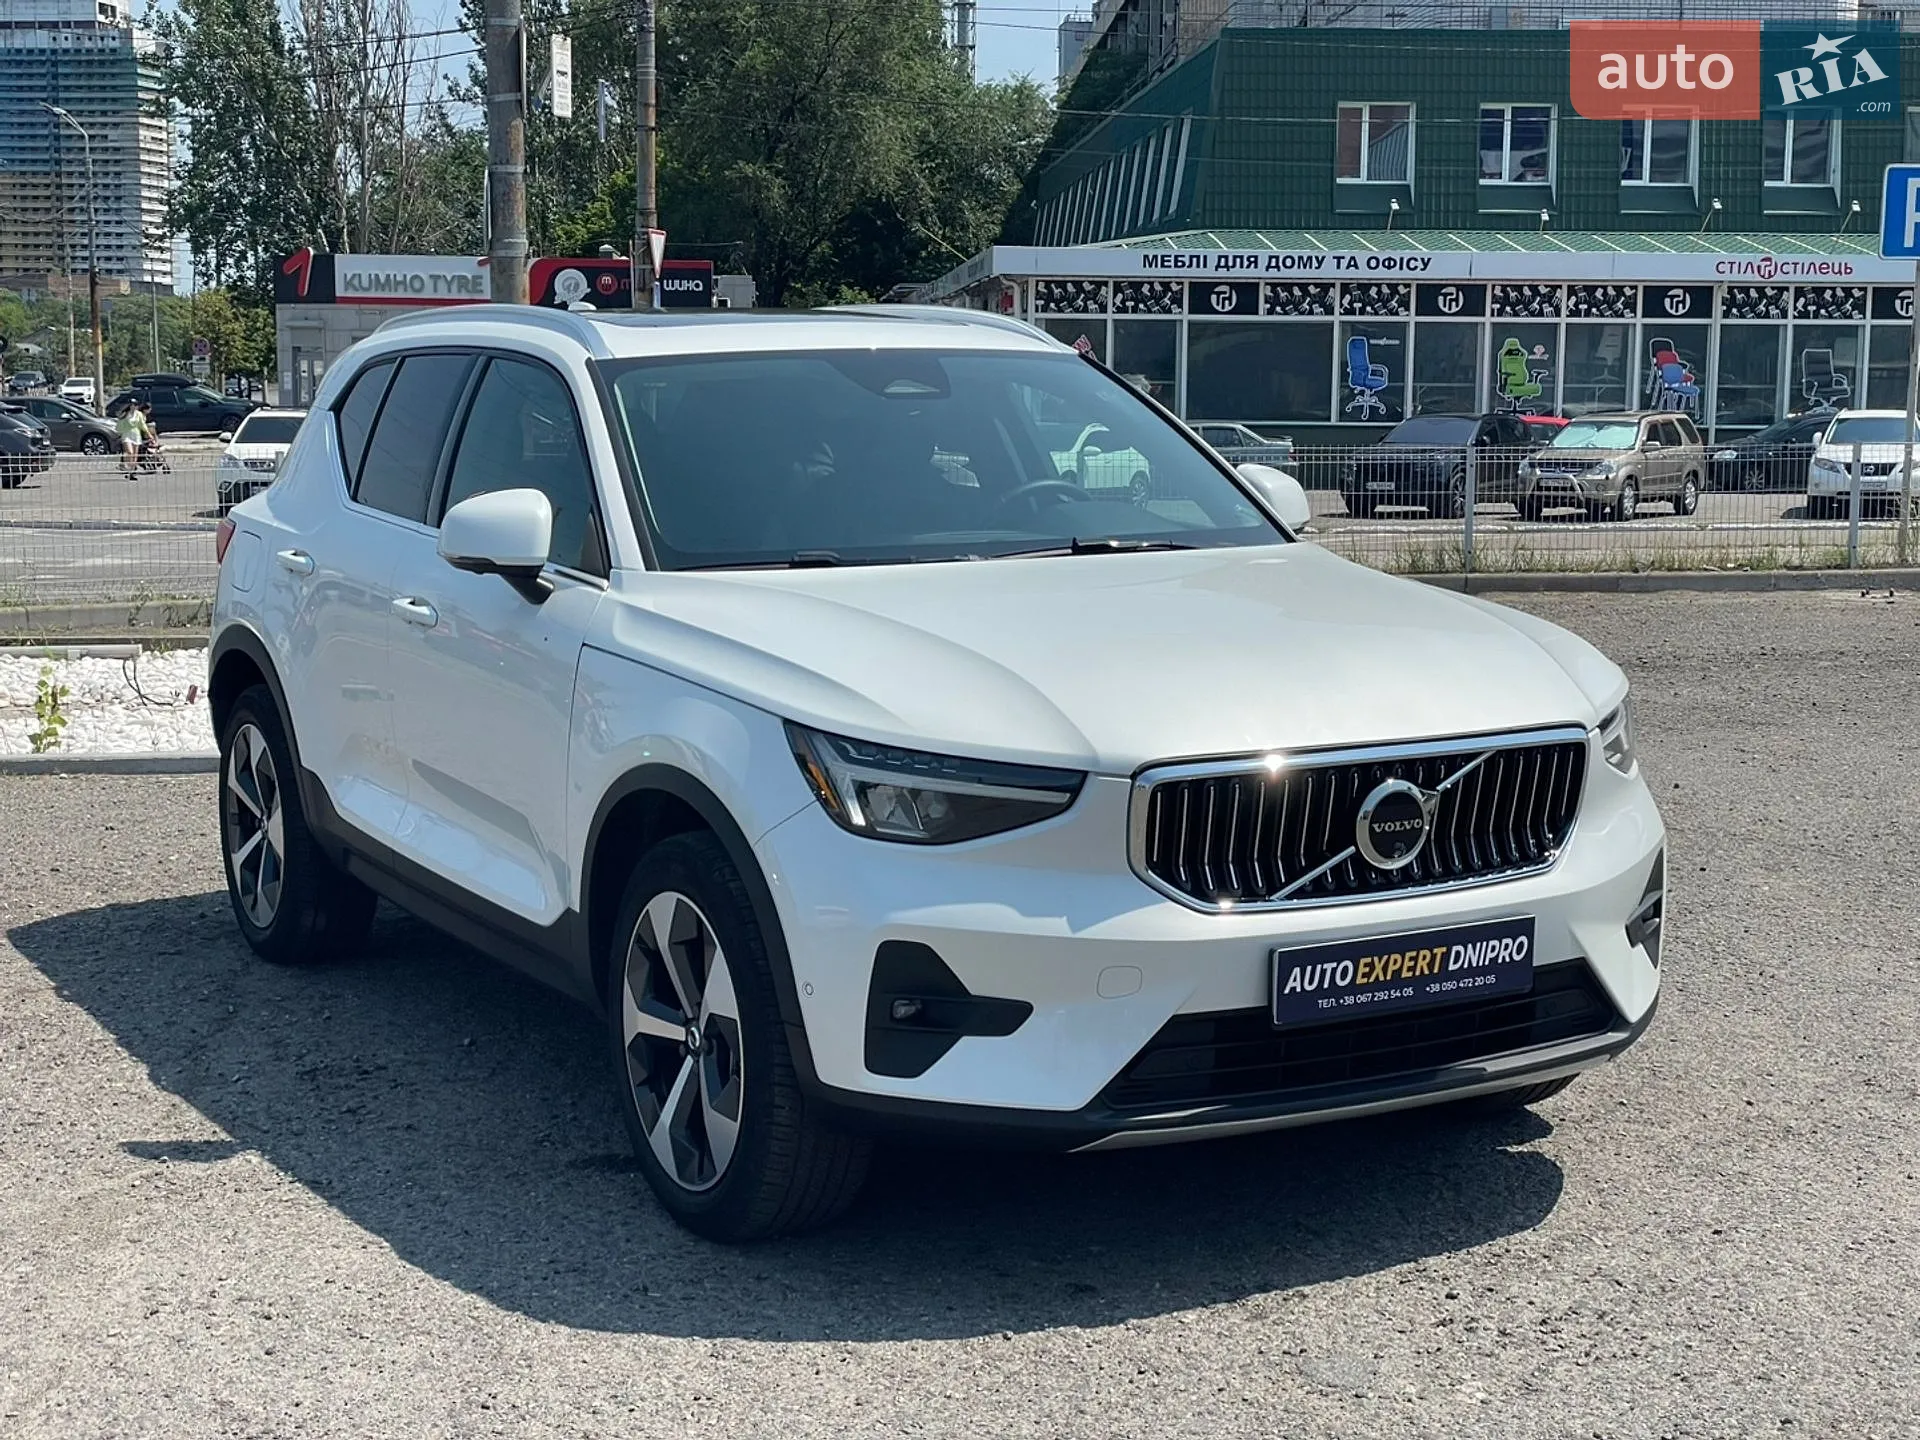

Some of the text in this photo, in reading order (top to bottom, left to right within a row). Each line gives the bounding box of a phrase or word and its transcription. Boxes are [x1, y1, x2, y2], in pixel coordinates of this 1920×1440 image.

[1142, 254, 1432, 272] МЕБЛІ ДЛЯ ДОМУ ТА ОФІСУ
[343, 272, 485, 295] KUMHO TYRE
[1371, 818, 1423, 832] VOLVO
[1283, 935, 1528, 994] AUTO EXPERT DNIPRO
[1425, 974, 1497, 993] +38 050 472 20 05
[1339, 996, 1354, 1006] +38
[1356, 993, 1372, 1004] 067
[1374, 990, 1388, 1001] 292
[1390, 988, 1401, 999] 54
[1402, 986, 1414, 997] 05
